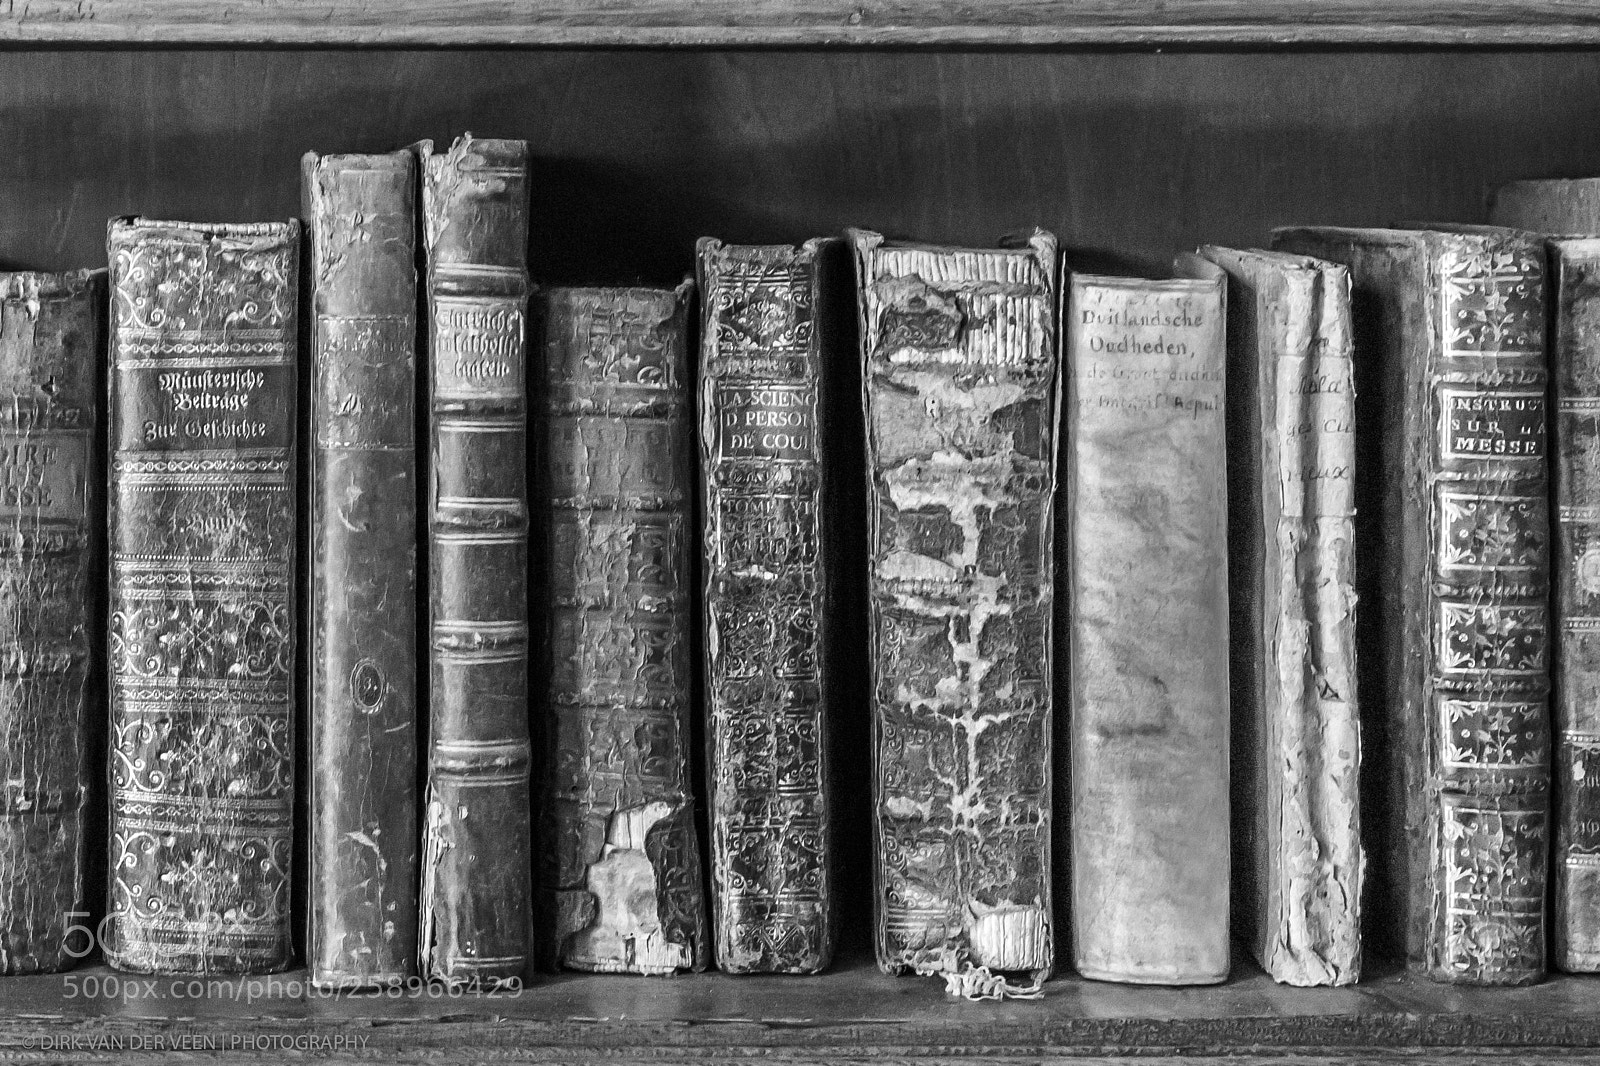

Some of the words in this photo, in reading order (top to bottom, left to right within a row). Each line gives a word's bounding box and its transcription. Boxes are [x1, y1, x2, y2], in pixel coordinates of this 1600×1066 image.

[144, 421, 178, 442] Zur
[731, 433, 754, 449] DE
[1455, 437, 1536, 455] MESSE
